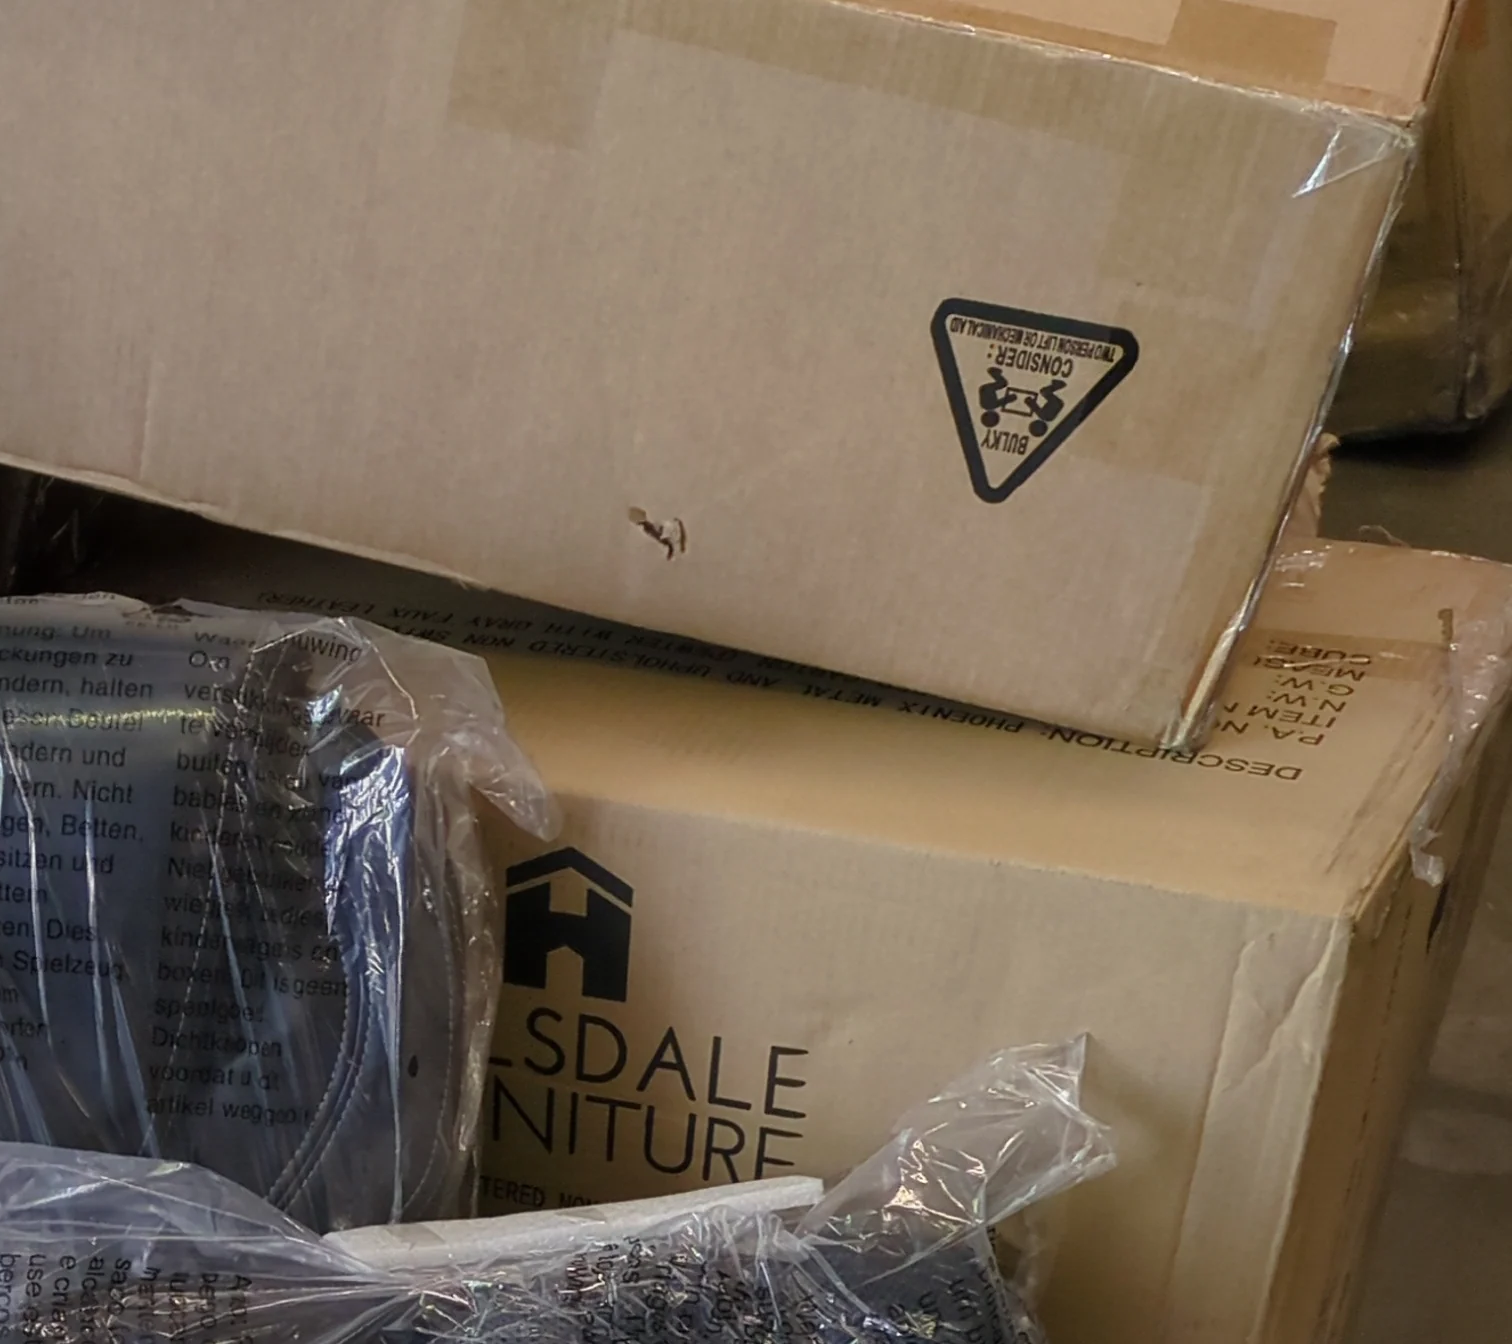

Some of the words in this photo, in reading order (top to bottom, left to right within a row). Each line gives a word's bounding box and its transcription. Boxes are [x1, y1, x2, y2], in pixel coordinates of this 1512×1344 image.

[951, 317, 968, 336] AID
[1024, 331, 1038, 349] OR
[1038, 334, 1058, 352] LIFT
[981, 429, 1029, 455] BULKY
[387, 606, 454, 625] FAUX
[464, 633, 515, 649] NON
[105, 652, 134, 666] zu
[528, 641, 711, 679] UPHOLSTERED
[80, 677, 154, 698] halten
[727, 669, 781, 688] AND
[802, 683, 883, 707] METAL
[898, 701, 1023, 734] PHOENIX
[1247, 706, 1336, 728] ITEM
[82, 747, 126, 767] und
[73, 778, 133, 803] Nicht
[489, 1006, 810, 1120] SDALE
